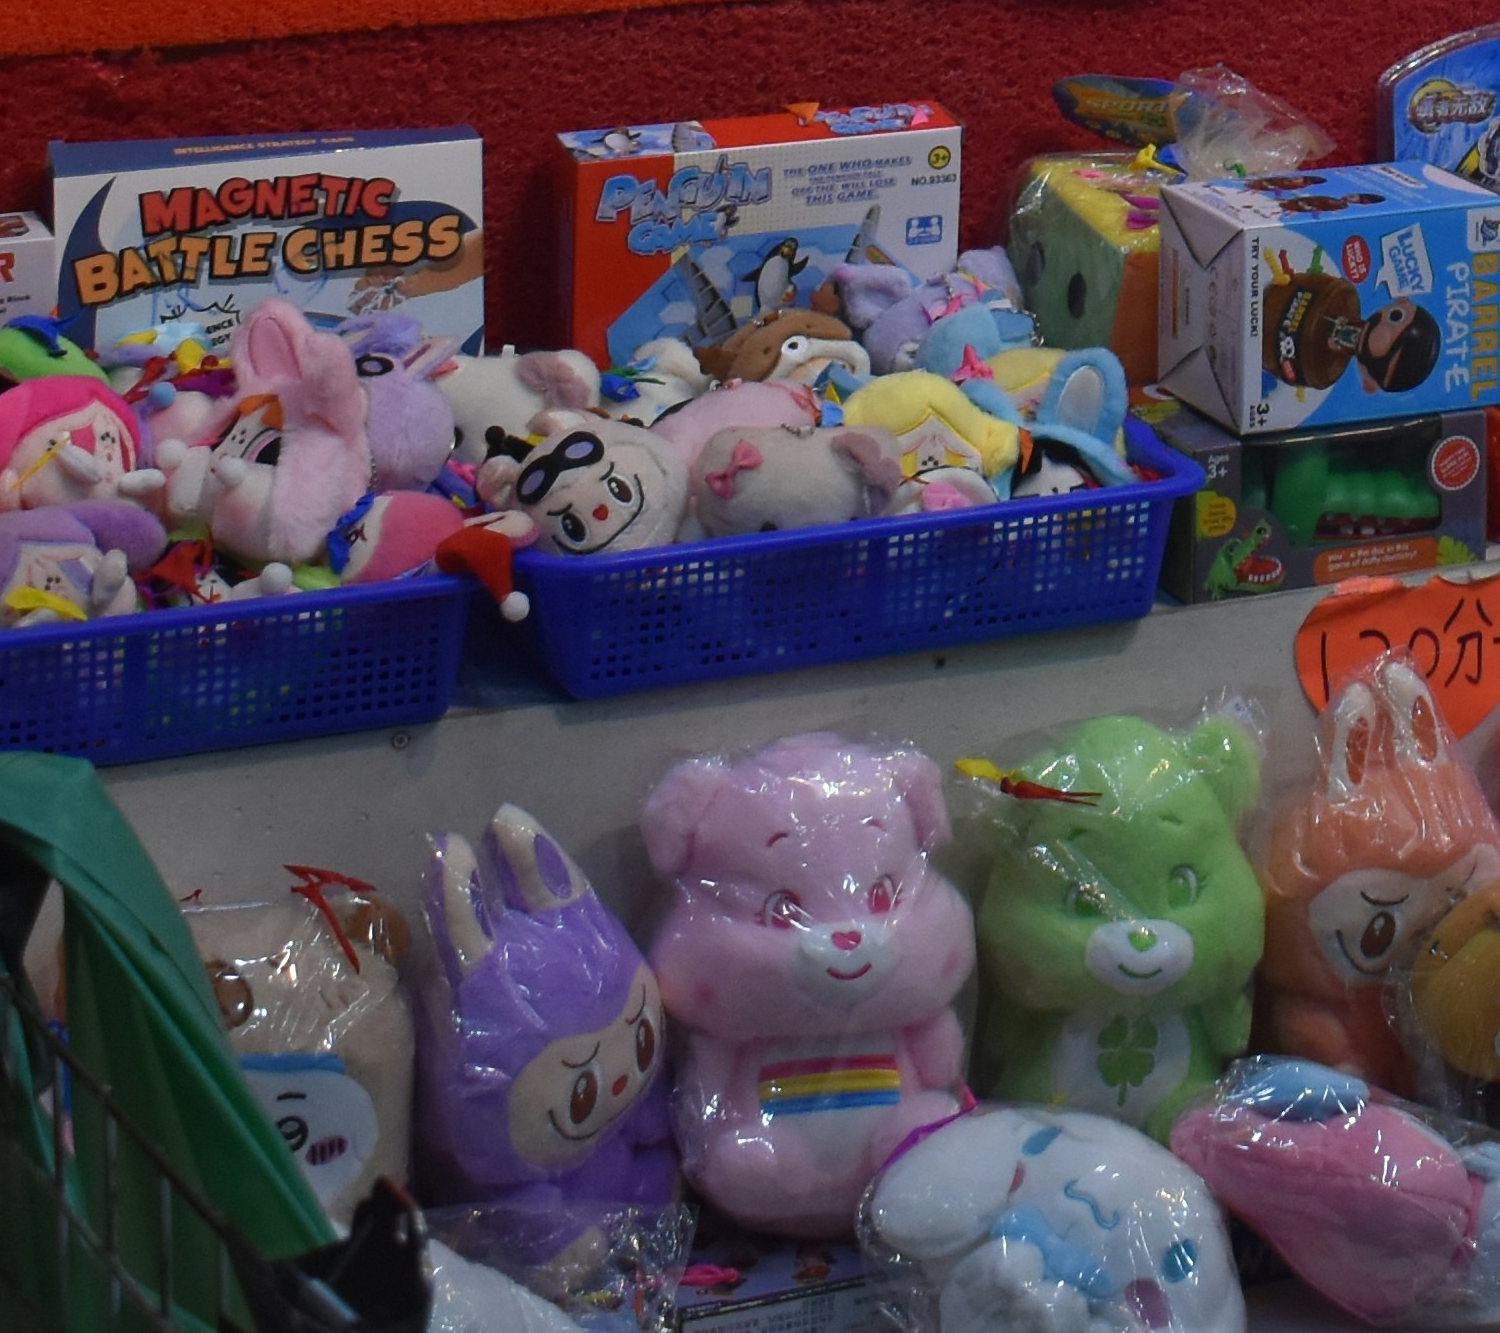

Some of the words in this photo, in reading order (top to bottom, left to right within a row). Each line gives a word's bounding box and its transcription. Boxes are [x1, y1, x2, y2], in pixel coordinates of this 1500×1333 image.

[807, 161, 837, 175] ONE
[839, 158, 872, 173] WHO
[932, 152, 949, 163] 3+
[139, 171, 397, 235] MAGNETIC
[596, 155, 773, 224] PENGUIN
[805, 194, 834, 206] THIS
[627, 208, 722, 256] GAME
[1251, 237, 1261, 258] TRY
[73, 231, 277, 307] BATTLE
[281, 213, 462, 274] CHESS
[1251, 262, 1261, 293] YOUR
[1388, 245, 1411, 291] GAME
[1397, 229, 1426, 294] LUCKY
[1250, 293, 1261, 338] LUCK!
[1445, 261, 1471, 393] PIRATE
[1470, 252, 1500, 402] BARREL
[1256, 403, 1270, 428] 3+
[1207, 464, 1229, 480] 3+
